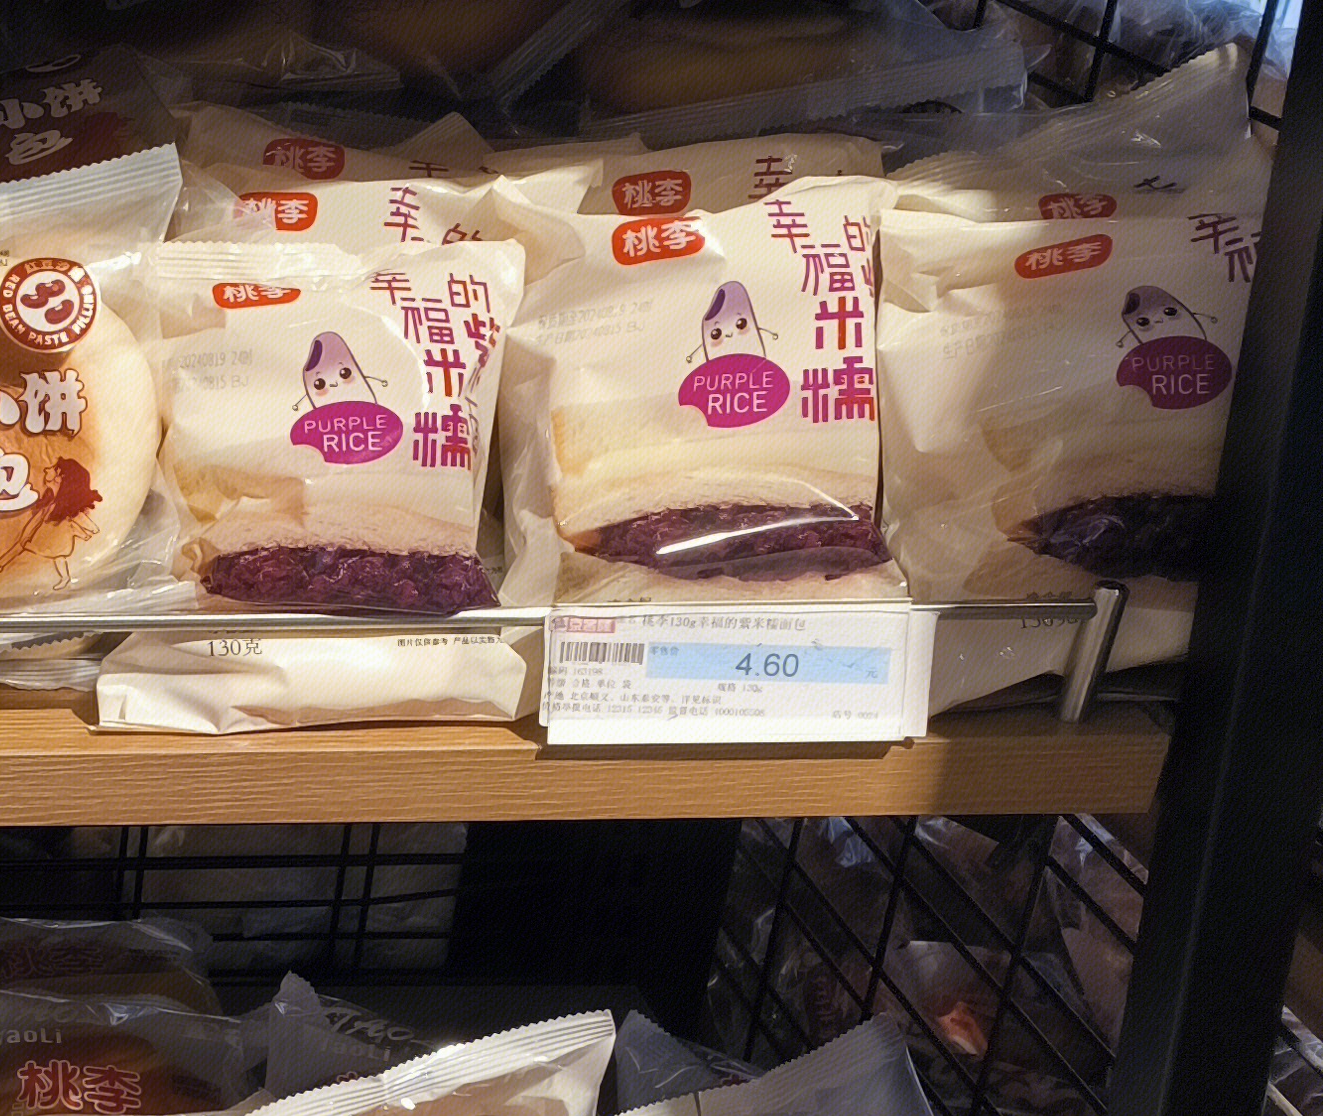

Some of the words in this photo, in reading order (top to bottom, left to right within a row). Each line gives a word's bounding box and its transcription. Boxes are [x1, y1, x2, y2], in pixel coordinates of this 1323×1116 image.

[621, 178, 684, 209] 桃李
[621, 222, 697, 258] 桃李
[1025, 241, 1102, 272] 桃李
[27, 329, 70, 347] PASTE
[1131, 353, 1216, 374] PURPLE
[692, 370, 776, 393] PURPLE
[1151, 373, 1212, 396] RICE
[707, 390, 769, 416] RICE
[304, 413, 389, 434] PURPLE
[322, 431, 384, 453] RICE
[206, 637, 263, 657] 130克
[734, 651, 800, 679] 4.60
[16, 1058, 142, 1115] 桃李
